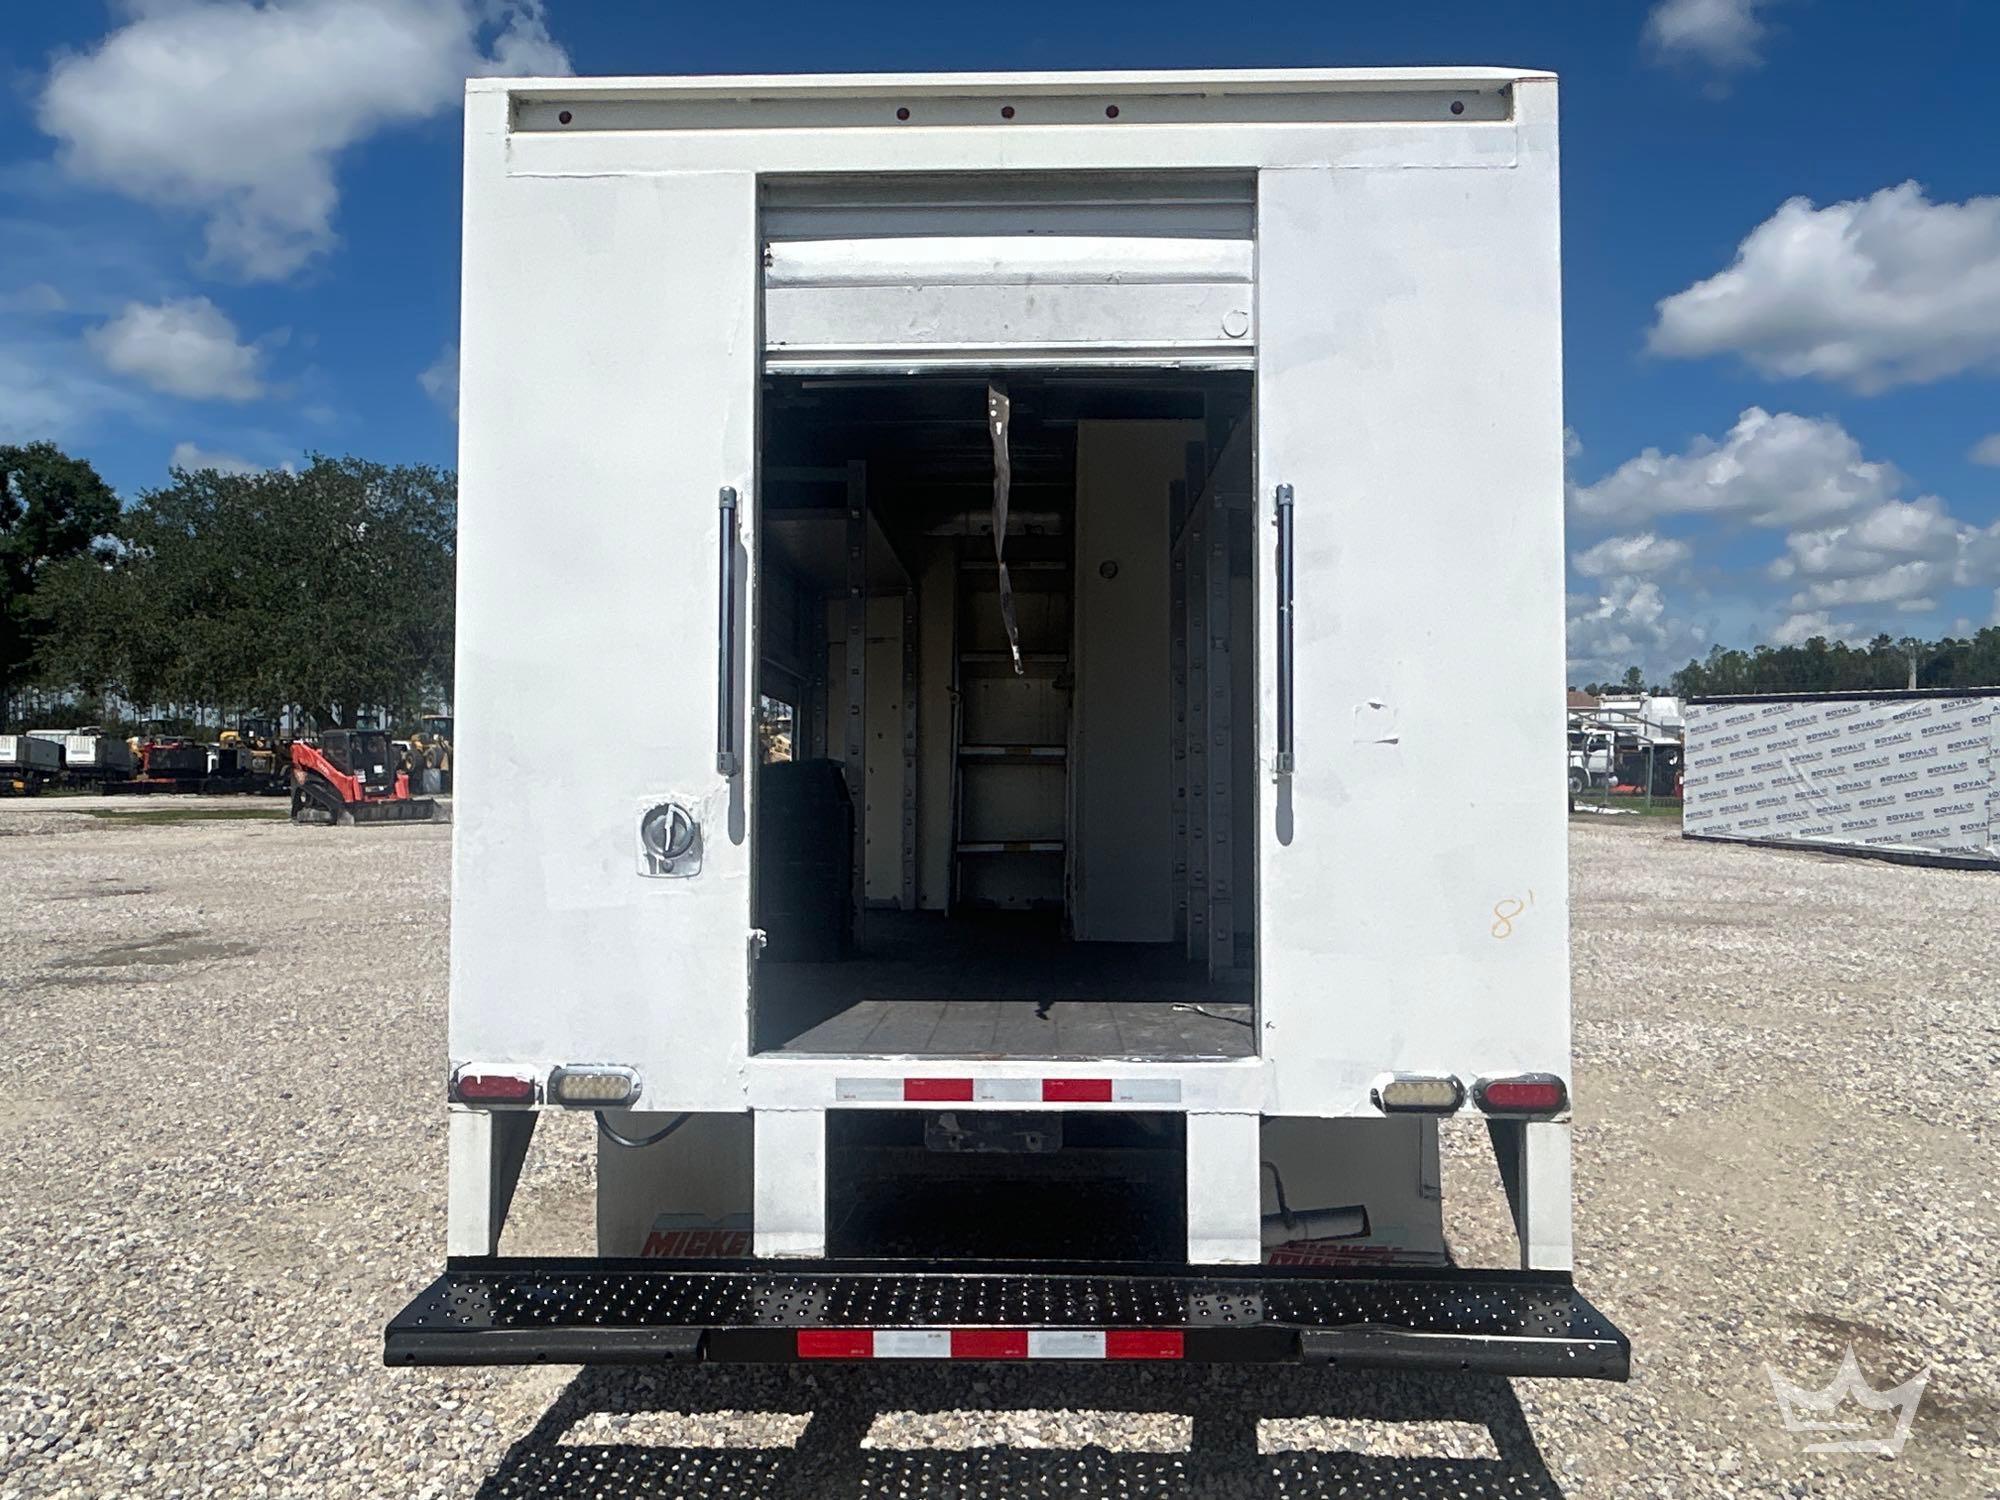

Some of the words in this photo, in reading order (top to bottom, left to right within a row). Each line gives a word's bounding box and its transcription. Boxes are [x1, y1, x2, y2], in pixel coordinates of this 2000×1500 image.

[1941, 699, 1973, 709] ROYAL
[1825, 707, 1852, 717] ROYAL
[1893, 709, 1922, 720] ROYAL
[1971, 715, 1991, 723] ROY
[1848, 720, 1876, 730] ROYAL
[1921, 723, 1952, 734] ROYAL
[1874, 733, 1904, 744] ROYAL
[1947, 738, 1979, 749] ROYAL
[1831, 743, 1858, 753] ROYAL
[1899, 749, 1929, 759] ROYAL
[1853, 758, 1880, 768] ROYAL
[1927, 763, 1958, 774] ROYAL
[1880, 773, 1908, 782] ROYAL
[1836, 781, 1864, 790] ROYAL
[1954, 780, 1986, 790] ROYAL
[1905, 789, 1935, 798] ROYAL
[1859, 797, 1887, 806] ROYAL
[1933, 804, 1964, 813] ROYAL
[1886, 812, 1916, 821] ROYAL
[1841, 819, 1868, 828] ROYAL
[1960, 822, 1986, 830] ROYA
[1911, 829, 1941, 837] ROYAL
[1865, 836, 1894, 844] ROYAL
[640, 1231, 753, 1257] MICKE
